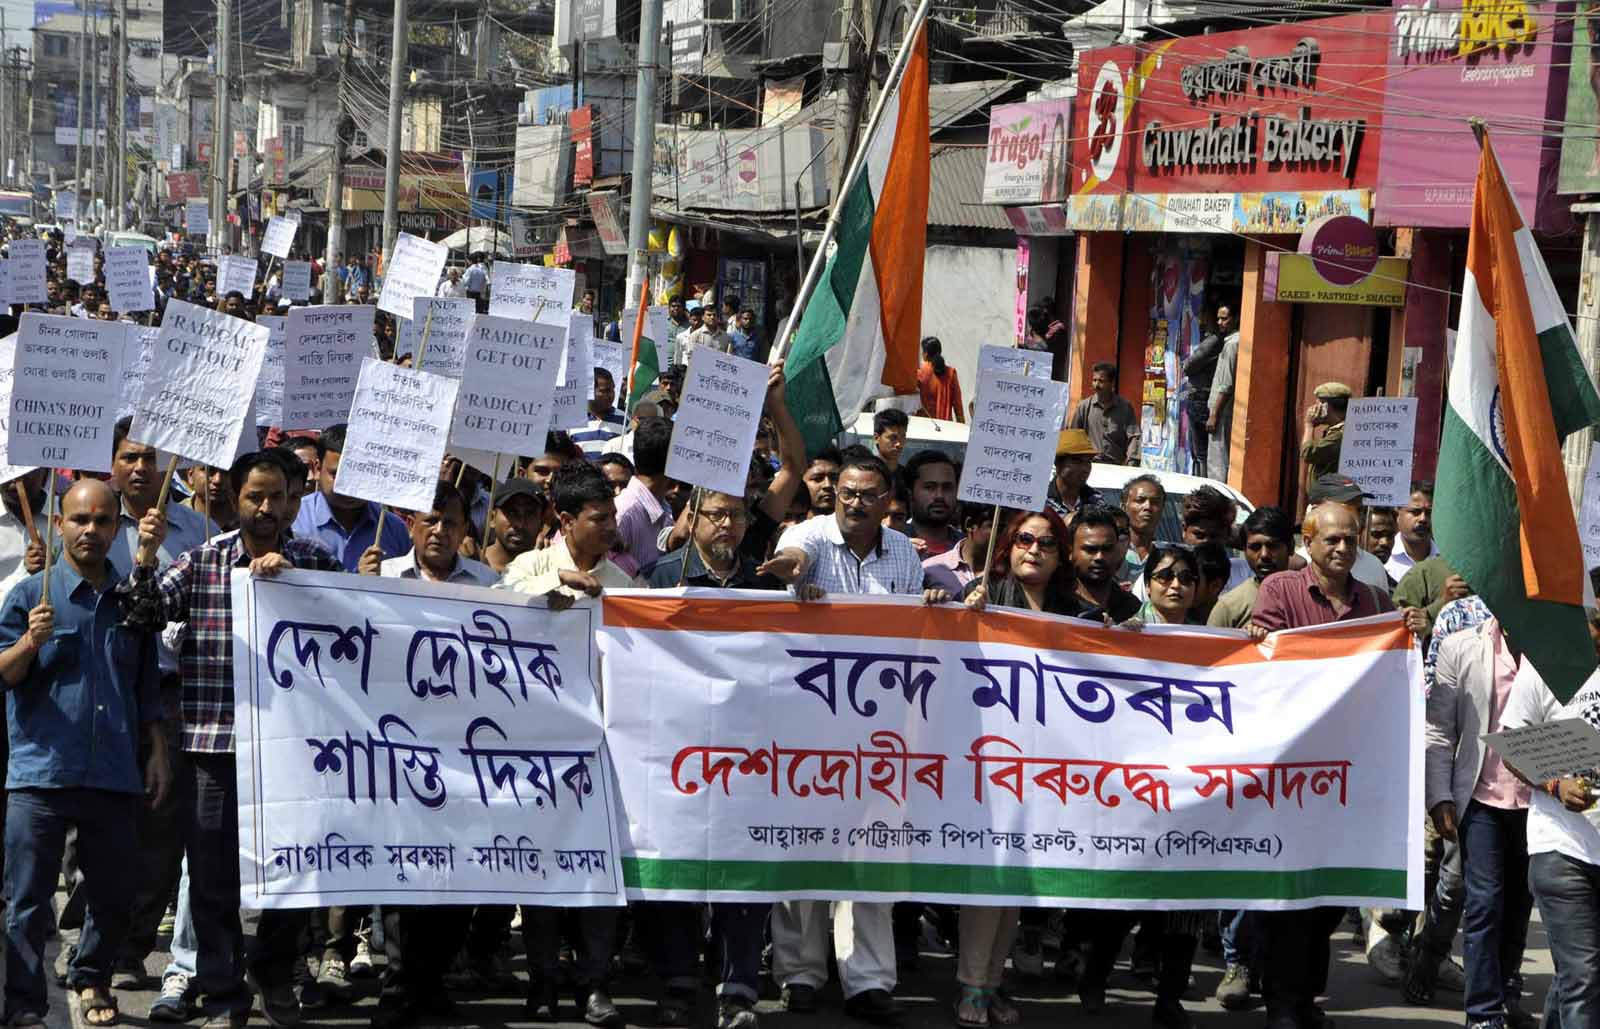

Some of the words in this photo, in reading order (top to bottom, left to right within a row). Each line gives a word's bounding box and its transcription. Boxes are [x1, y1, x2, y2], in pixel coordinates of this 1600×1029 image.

[1143, 110, 1257, 170] Guwahati
[1263, 106, 1364, 178] Bakery
[1168, 198, 1201, 211] GUWAHATI
[1204, 198, 1232, 212] BAKERY
[400, 214, 436, 229] CHICKEN
[1280, 290, 1310, 300] CAKES
[1317, 291, 1358, 301] PASTRIES
[1366, 294, 1402, 303] SNACKS
[167, 338, 202, 361] GET
[207, 350, 245, 372] OUT
[475, 348, 511, 365] GET
[512, 353, 545, 371] OUT
[69, 402, 105, 419] BOOT
[15, 420, 73, 439] LICKERS
[73, 426, 101, 440] GET
[464, 415, 498, 431] GET
[500, 420, 533, 436] OUT
[42, 446, 69, 461] OUT
[267, 618, 380, 695] দেশ
[785, 649, 941, 722] বন্দে
[961, 653, 1238, 735] মাতৰম
[306, 713, 447, 811] শাস্তি
[459, 716, 596, 811] দিয়ক
[963, 734, 1171, 813] বিৰুদ্ধে
[1187, 759, 1352, 809] সমদল
[272, 832, 374, 873] নাগৰিক
[384, 843, 456, 881] সুৰক্ষা
[554, 848, 607, 873] অসম
[1090, 833, 1146, 854] অসম
[1154, 830, 1283, 858] (পিপিএফএ)
